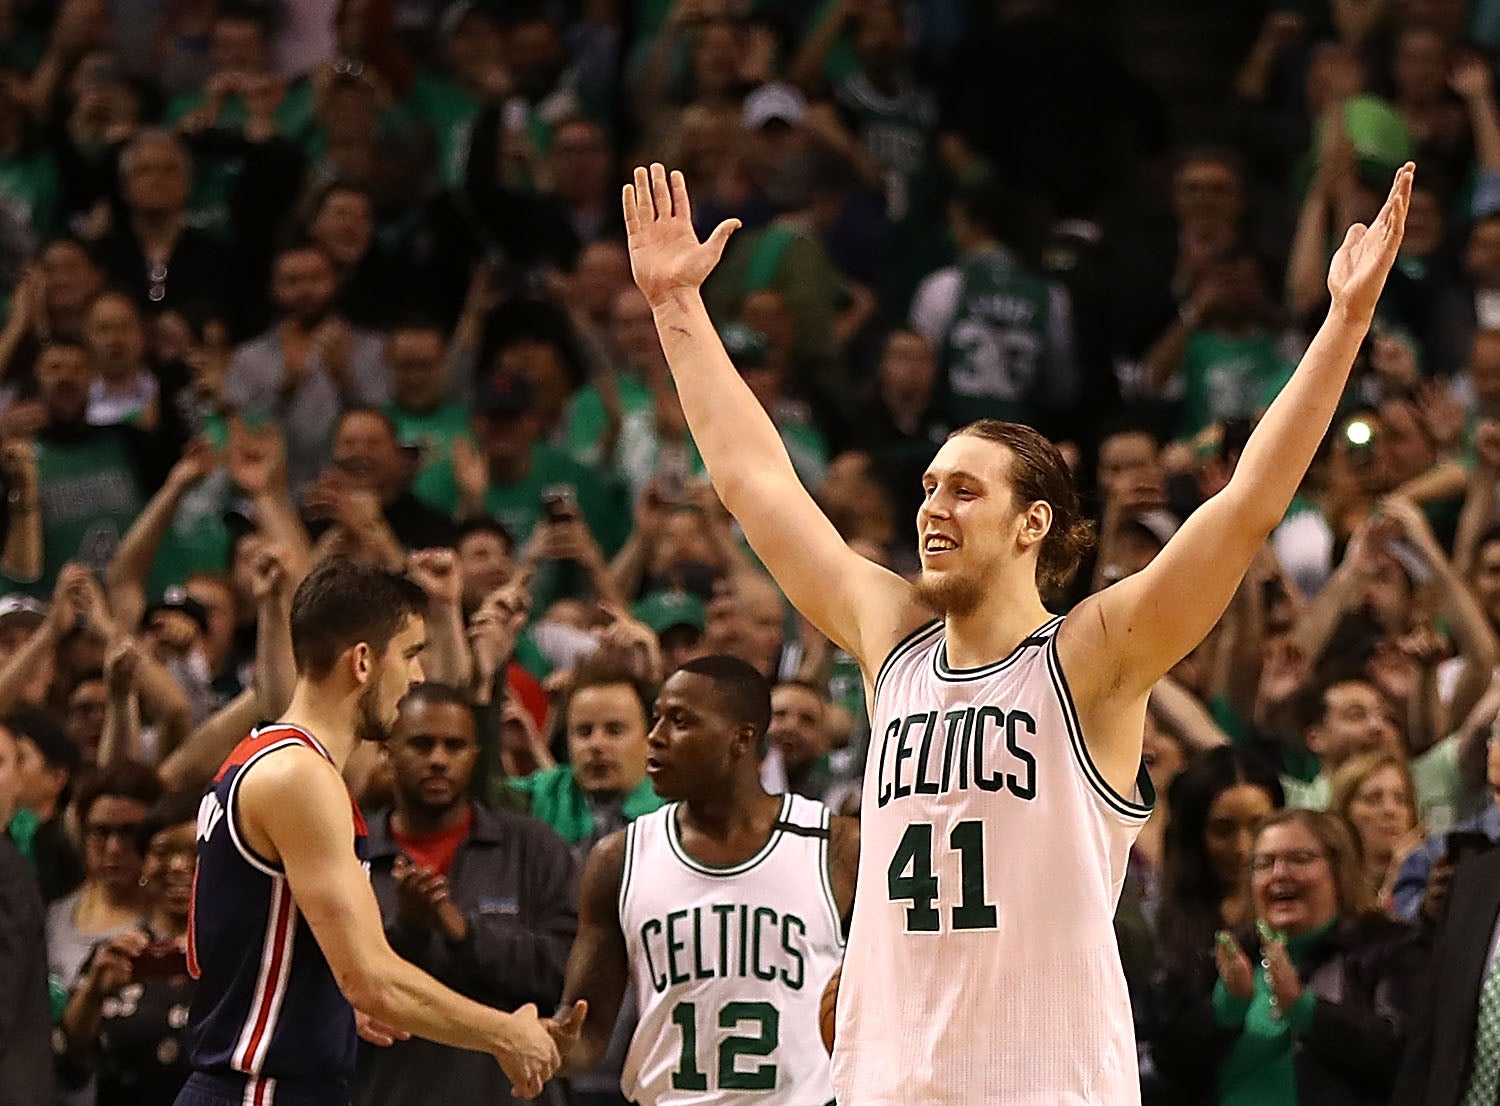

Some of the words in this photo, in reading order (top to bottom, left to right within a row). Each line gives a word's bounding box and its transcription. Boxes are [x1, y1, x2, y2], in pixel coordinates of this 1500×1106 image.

[878, 705, 1036, 809] CELTICS
[886, 819, 999, 934] 41
[640, 904, 807, 993] CELTICS
[671, 1000, 780, 1092] 12
